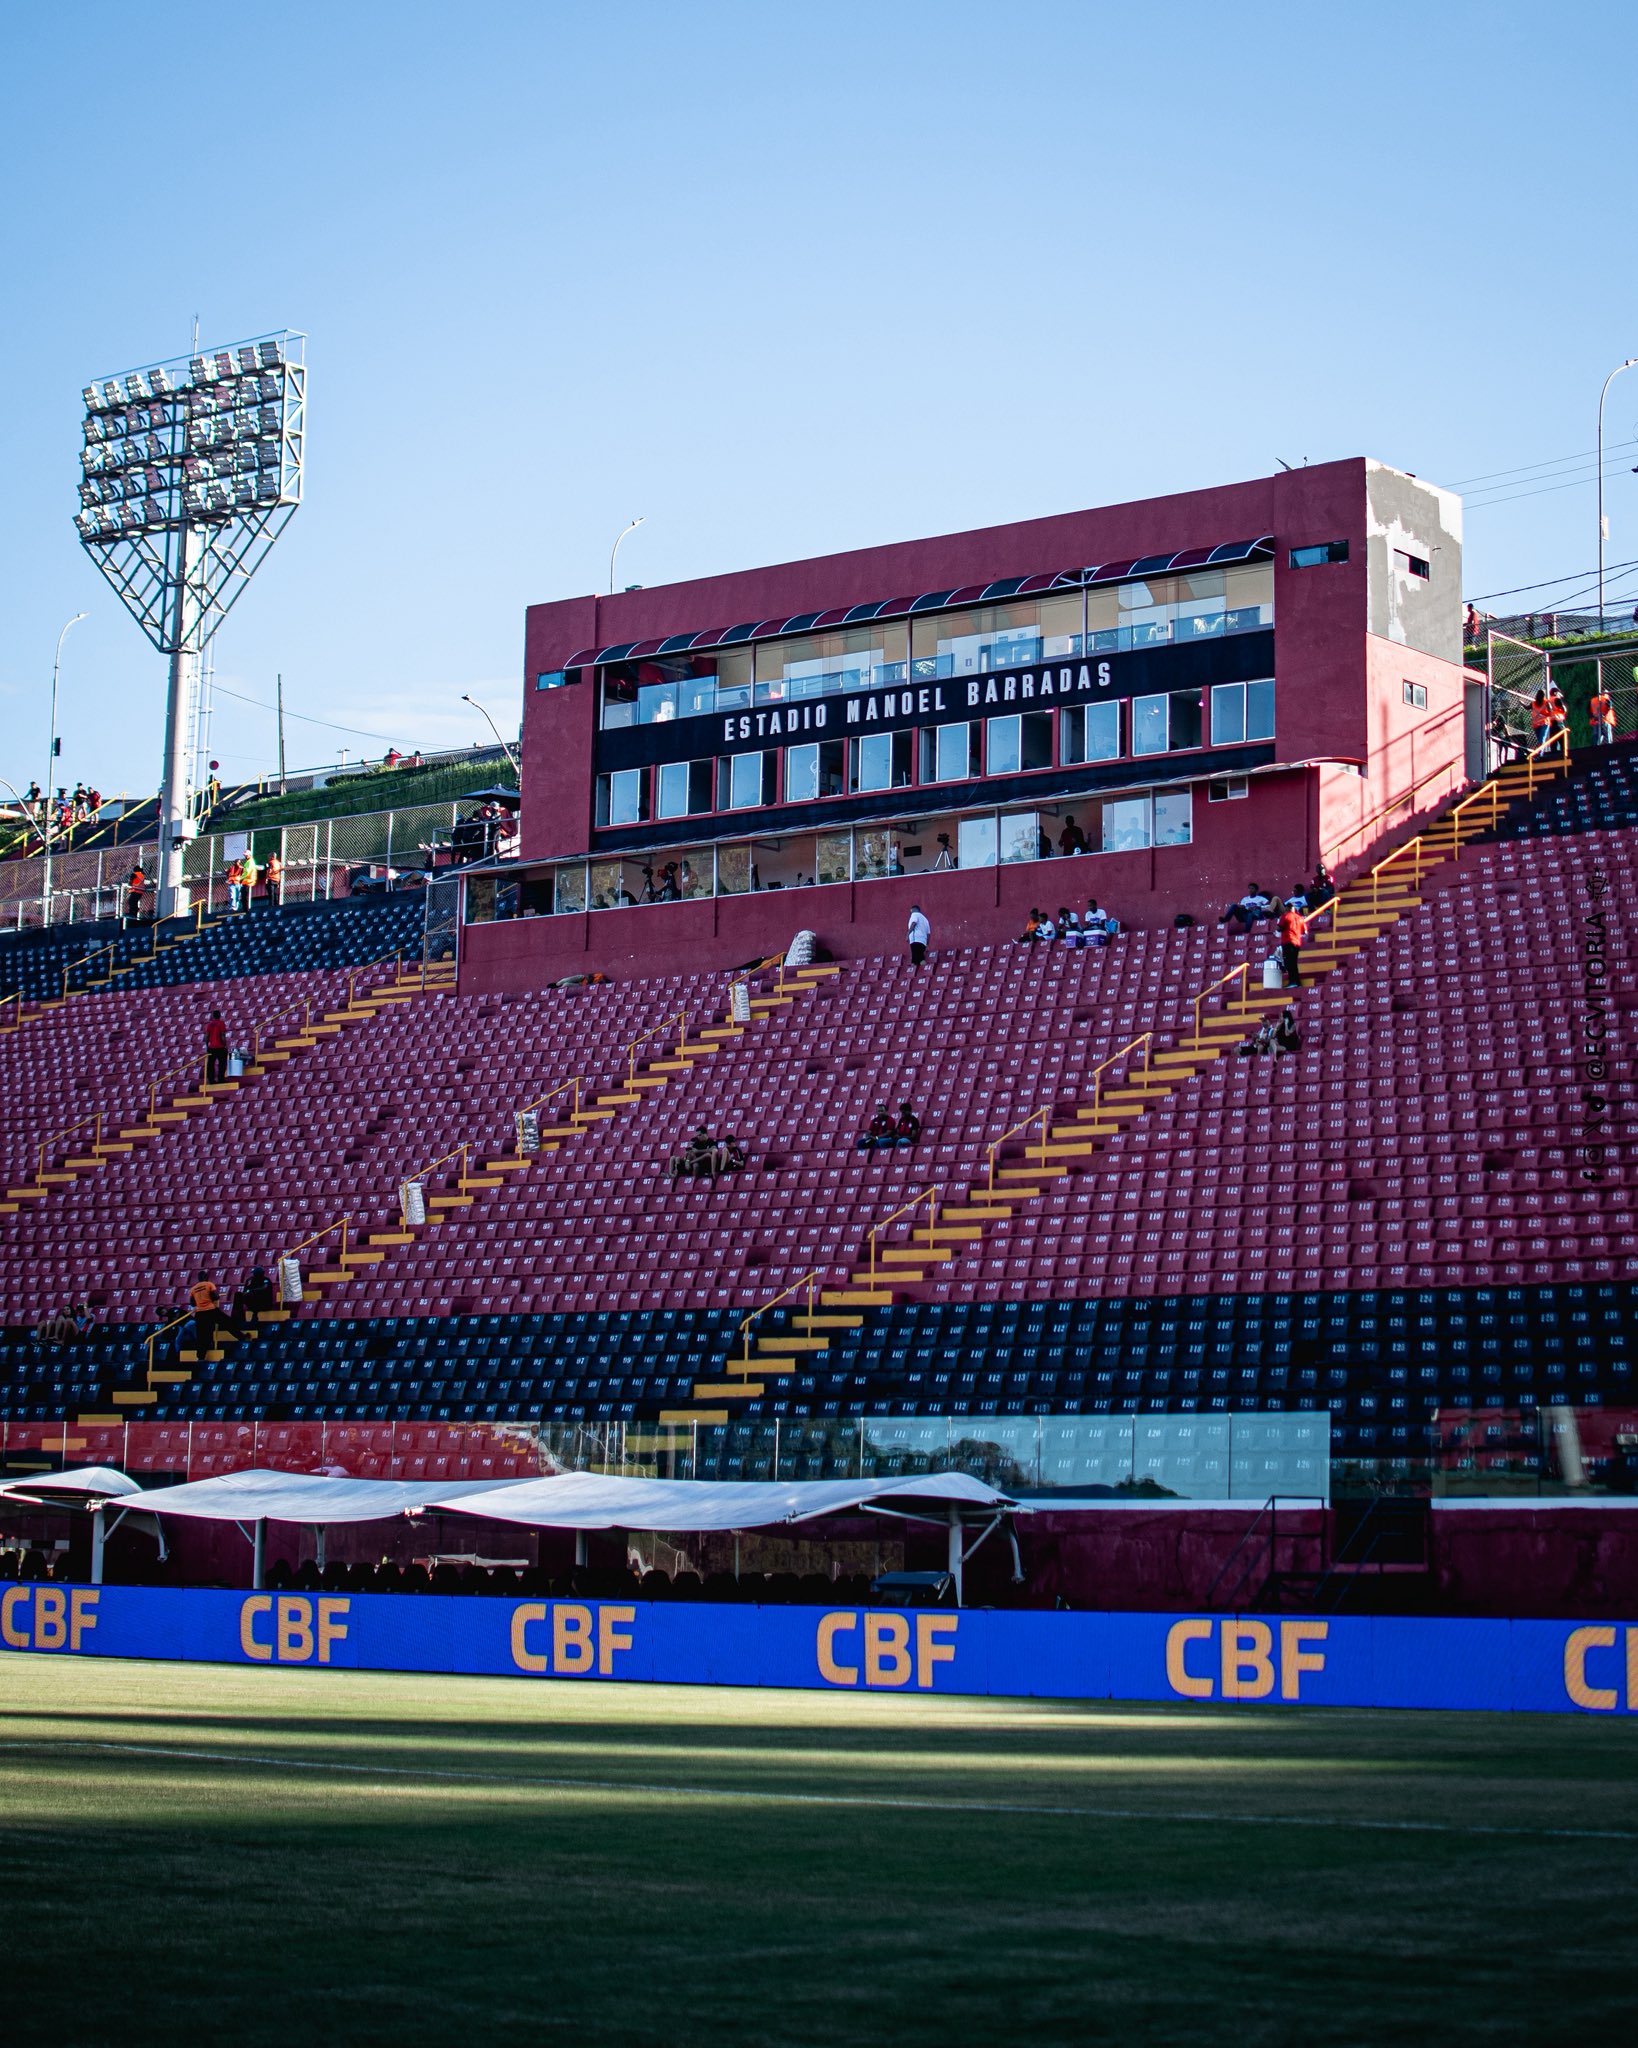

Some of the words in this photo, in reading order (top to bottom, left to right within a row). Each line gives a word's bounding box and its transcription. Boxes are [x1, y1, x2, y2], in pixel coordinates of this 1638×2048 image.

[724, 704, 826, 742] ESTADIO
[846, 687, 946, 723] MANOEL
[967, 654, 1111, 706] BARRADAS
[1, 1585, 101, 1651] CBF
[240, 1594, 350, 1663] CBF
[510, 1602, 636, 1674] CBF
[816, 1611, 959, 1688] CBF
[1166, 1619, 1329, 1700] CBF
[1564, 1626, 1638, 1710] C
